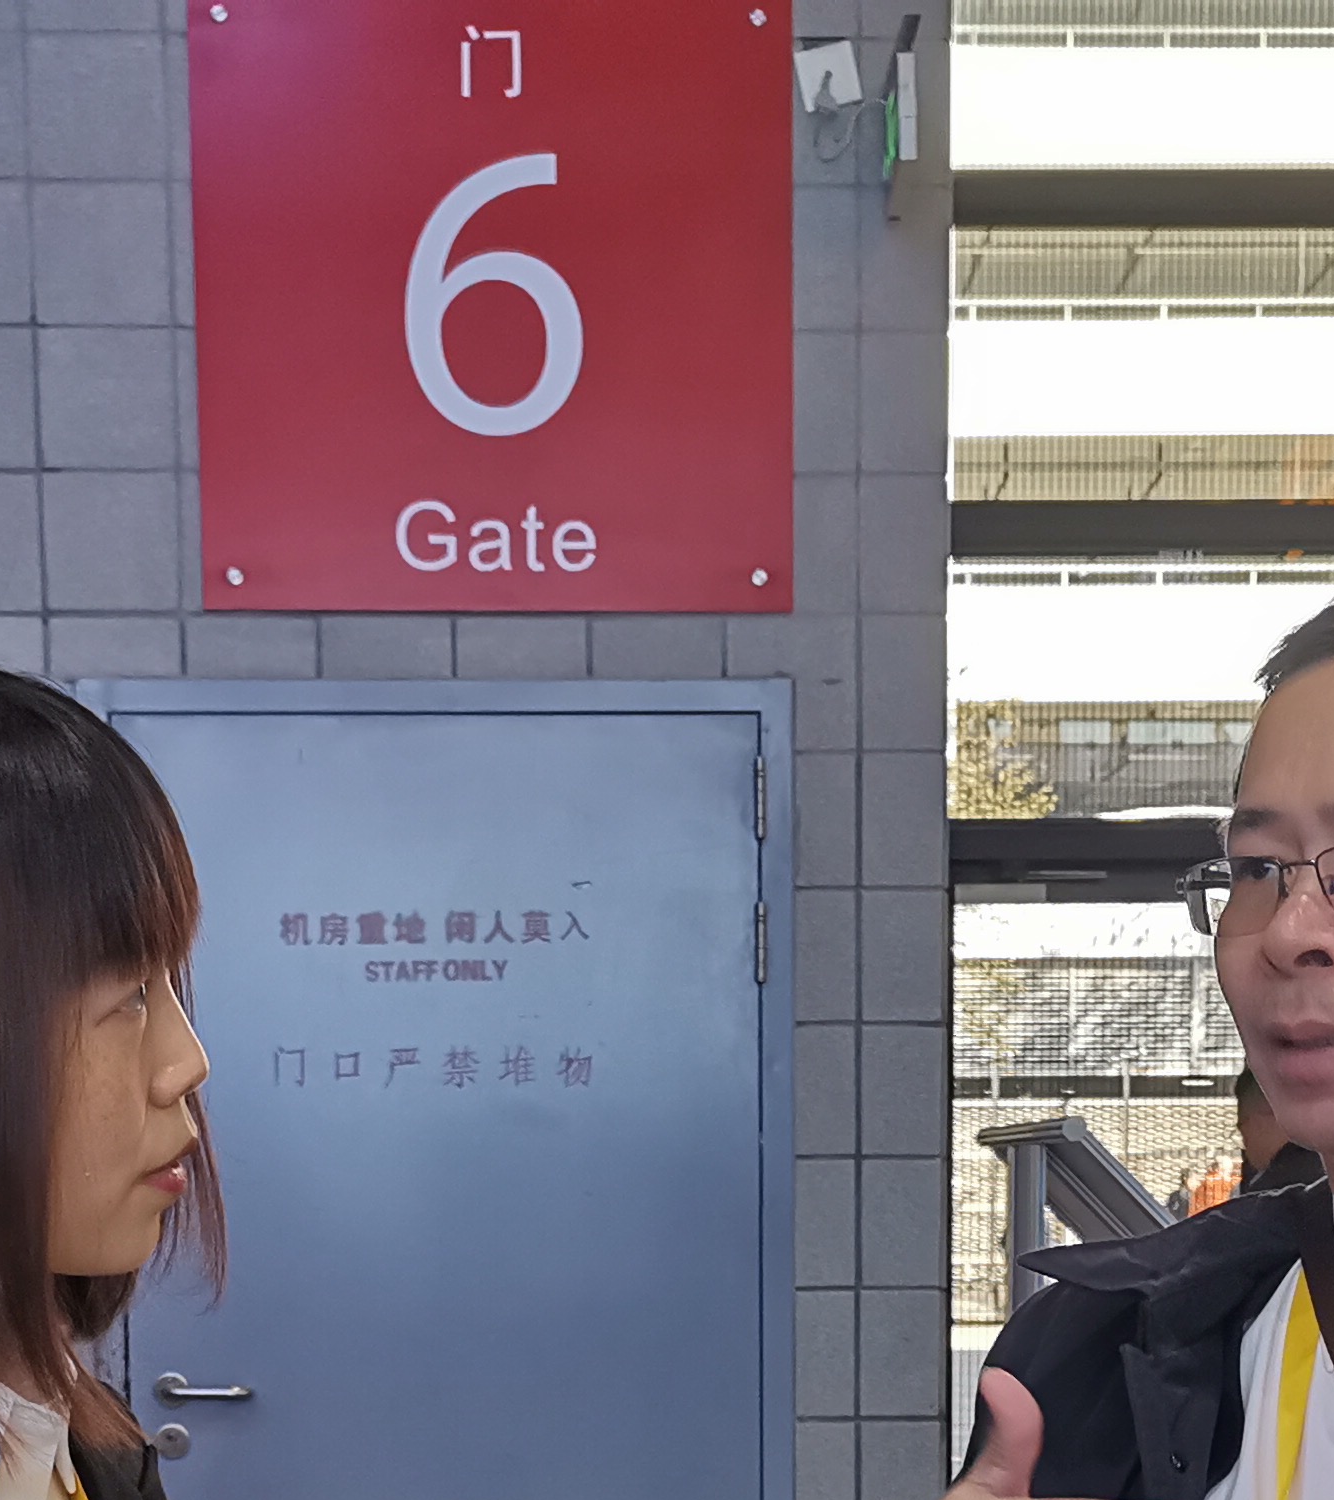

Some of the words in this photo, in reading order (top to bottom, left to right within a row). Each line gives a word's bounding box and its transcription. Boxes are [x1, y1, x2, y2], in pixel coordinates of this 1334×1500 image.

[460, 25, 522, 98] 门
[404, 153, 584, 437] 6
[395, 500, 598, 573] Gate
[279, 911, 427, 946] 机房重地
[365, 960, 438, 983] STAFF
[443, 959, 509, 982] ONLY
[272, 1044, 594, 1090] 门口严禁堆物
